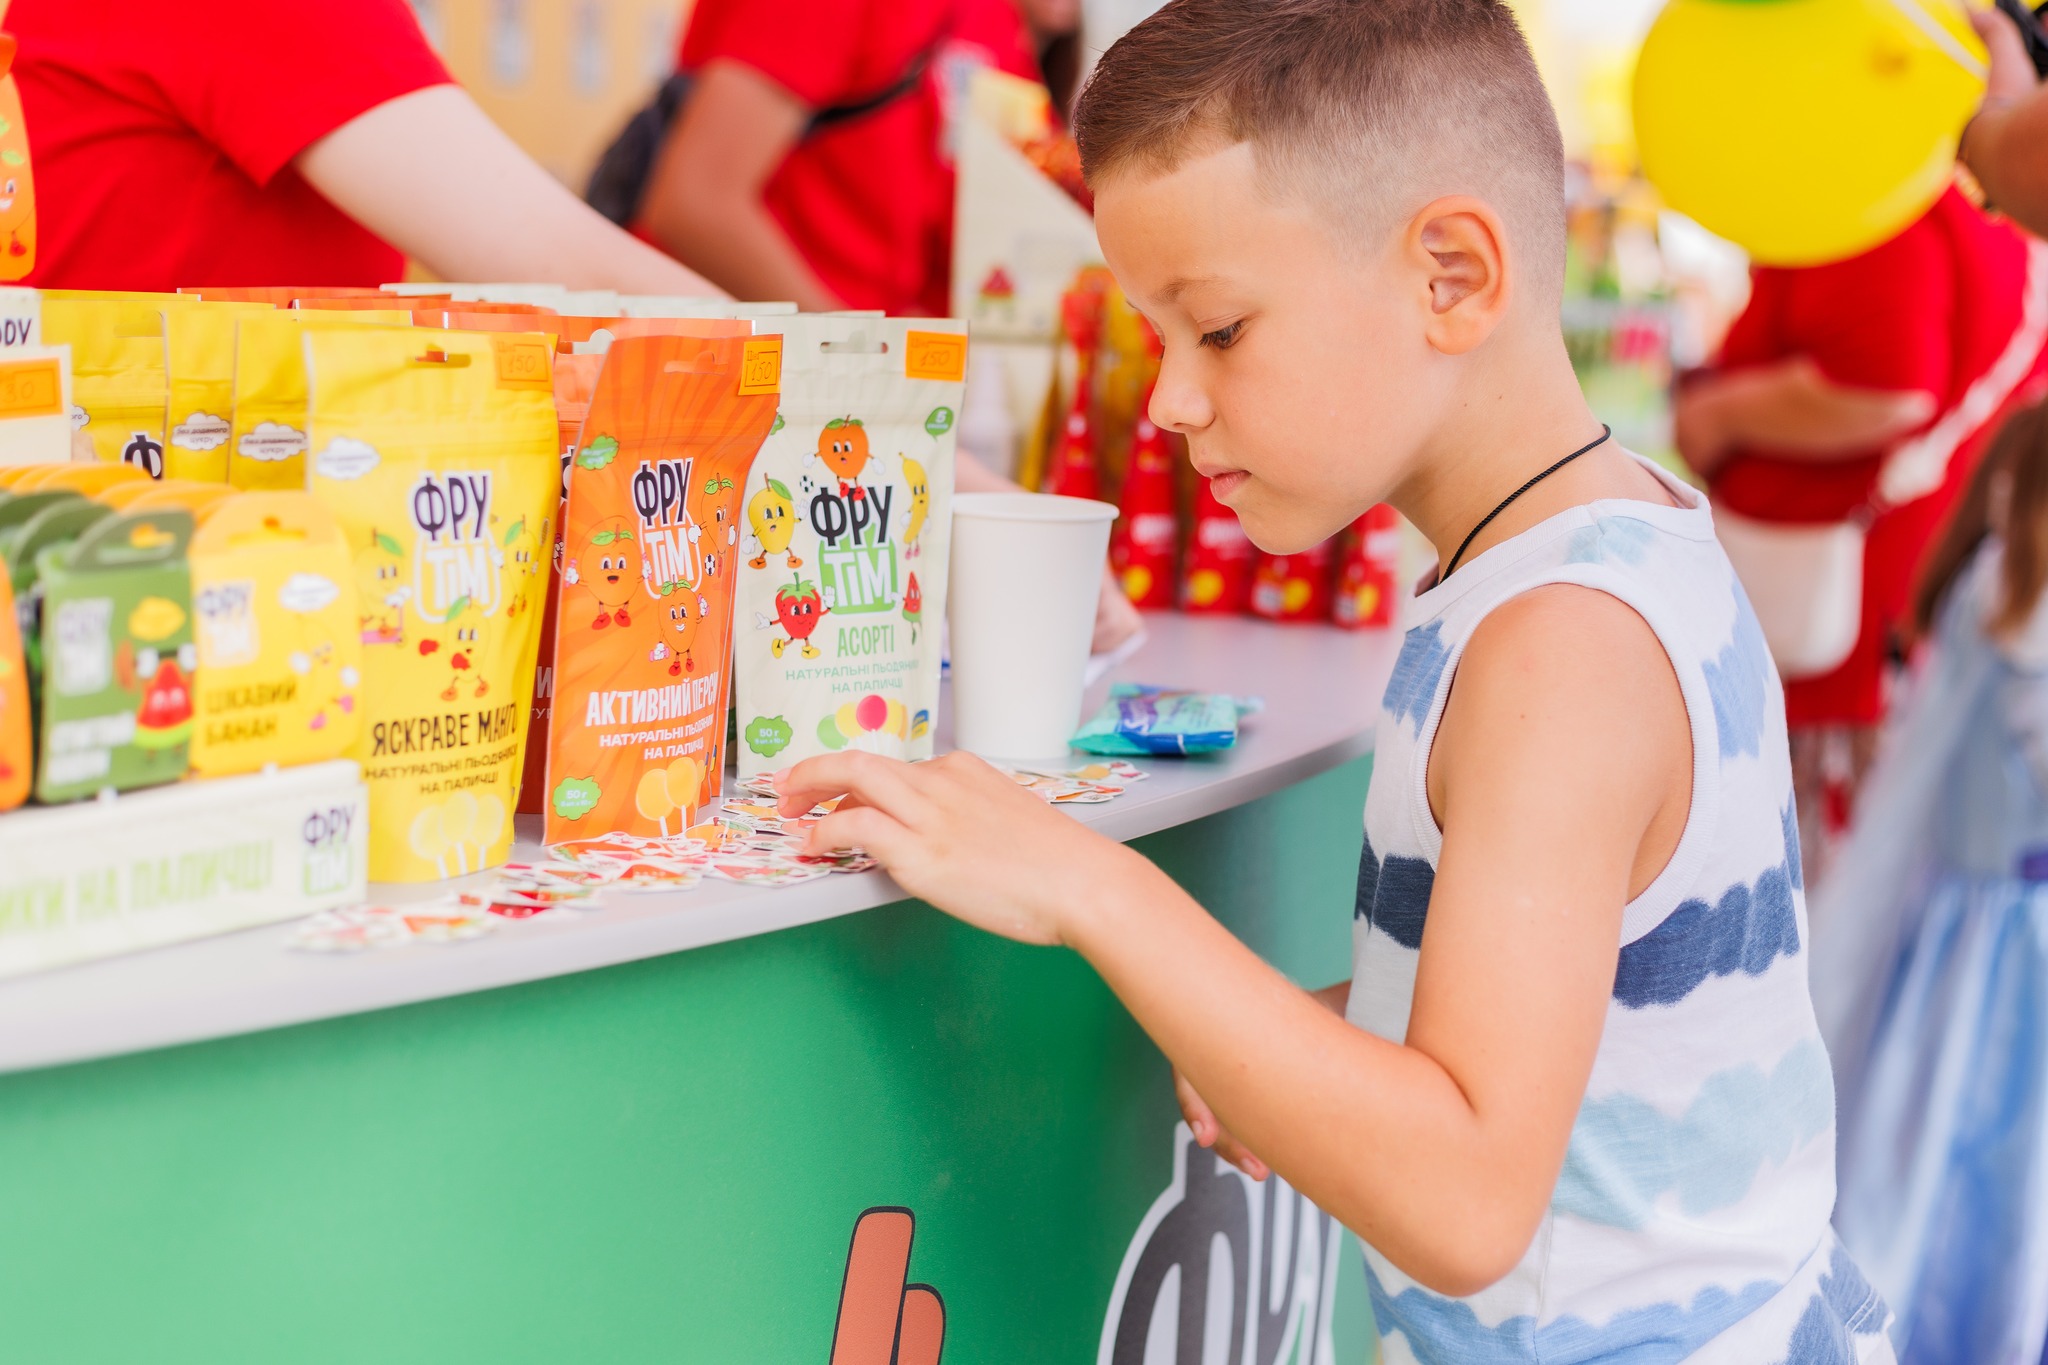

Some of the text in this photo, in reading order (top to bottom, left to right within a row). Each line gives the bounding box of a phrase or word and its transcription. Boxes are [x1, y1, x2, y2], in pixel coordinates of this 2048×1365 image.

[751, 361, 773, 381] 150
[920, 350, 951, 367] 150
[634, 461, 692, 526] ФРУ
[414, 476, 487, 541] ФРУ
[810, 486, 892, 546] ФРУ
[837, 624, 895, 658] АСОРТІ
[785, 663, 870, 681] НАТУРАЛЬНІ
[832, 683, 850, 693] НА
[585, 678, 691, 727] АКТИВНИЙ
[206, 716, 278, 746] БАНАН
[372, 702, 517, 757] ЯСКРАВЕ МАНГО
[600, 726, 683, 747] НАТУРАЛЬНІ
[644, 748, 663, 760] НА
[365, 760, 462, 779] НАТУРАЛЬНІ
[420, 781, 440, 794] НА
[303, 804, 356, 847] ФРУ
